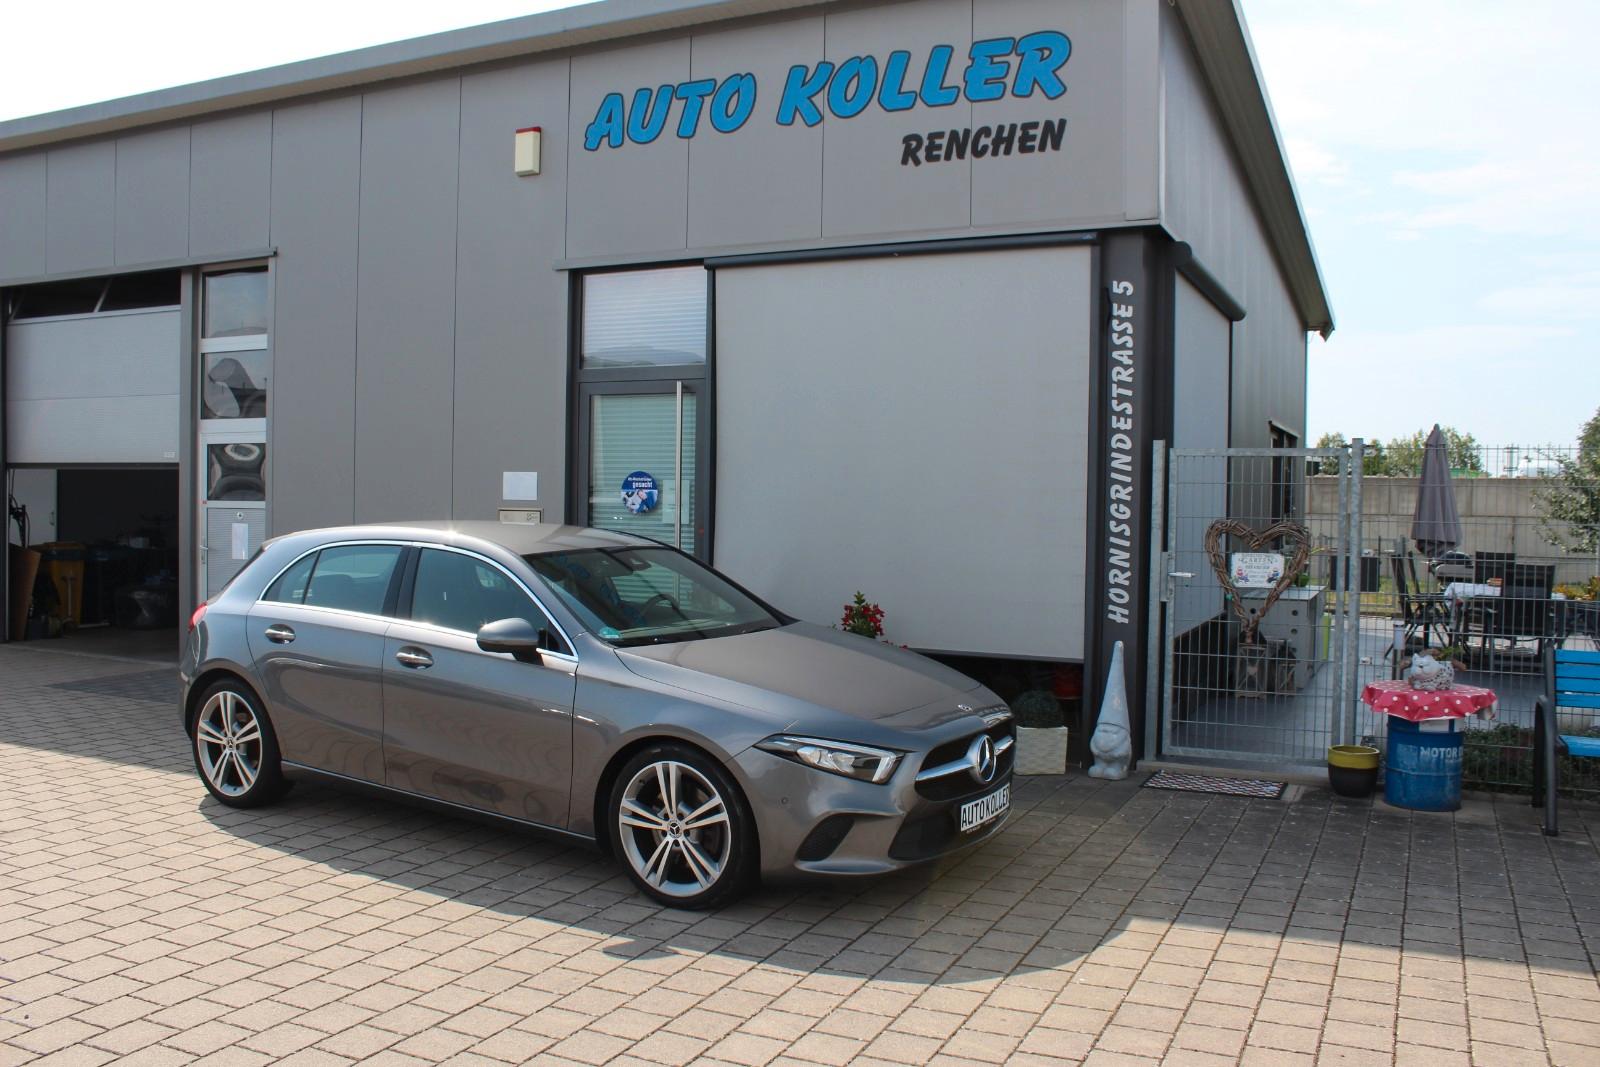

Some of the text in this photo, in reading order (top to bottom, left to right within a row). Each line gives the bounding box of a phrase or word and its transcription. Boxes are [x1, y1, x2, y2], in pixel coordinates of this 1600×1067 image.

[584, 30, 1072, 151] AUTO KOLLER
[900, 118, 1067, 166] RENCHEN
[1107, 280, 1135, 624] HORNISGRINDESTRASSE 5
